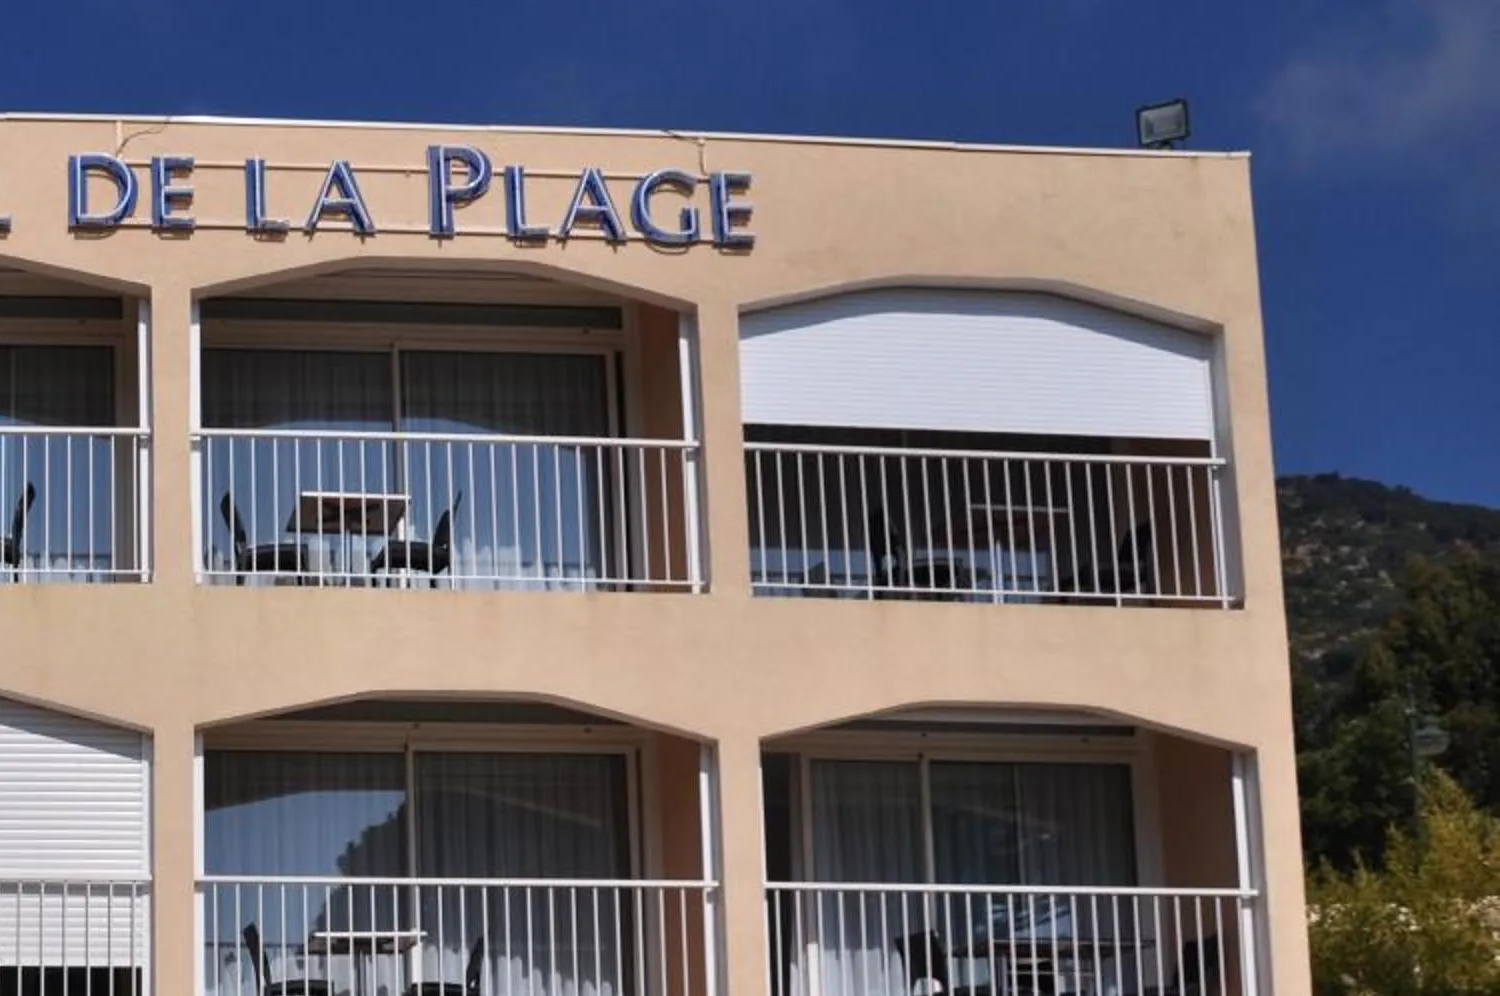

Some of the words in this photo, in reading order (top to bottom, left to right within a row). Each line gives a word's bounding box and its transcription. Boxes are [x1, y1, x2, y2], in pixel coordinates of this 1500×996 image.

[68, 154, 194, 234] DE
[244, 157, 377, 238] LA
[427, 144, 756, 250] PLAGE
